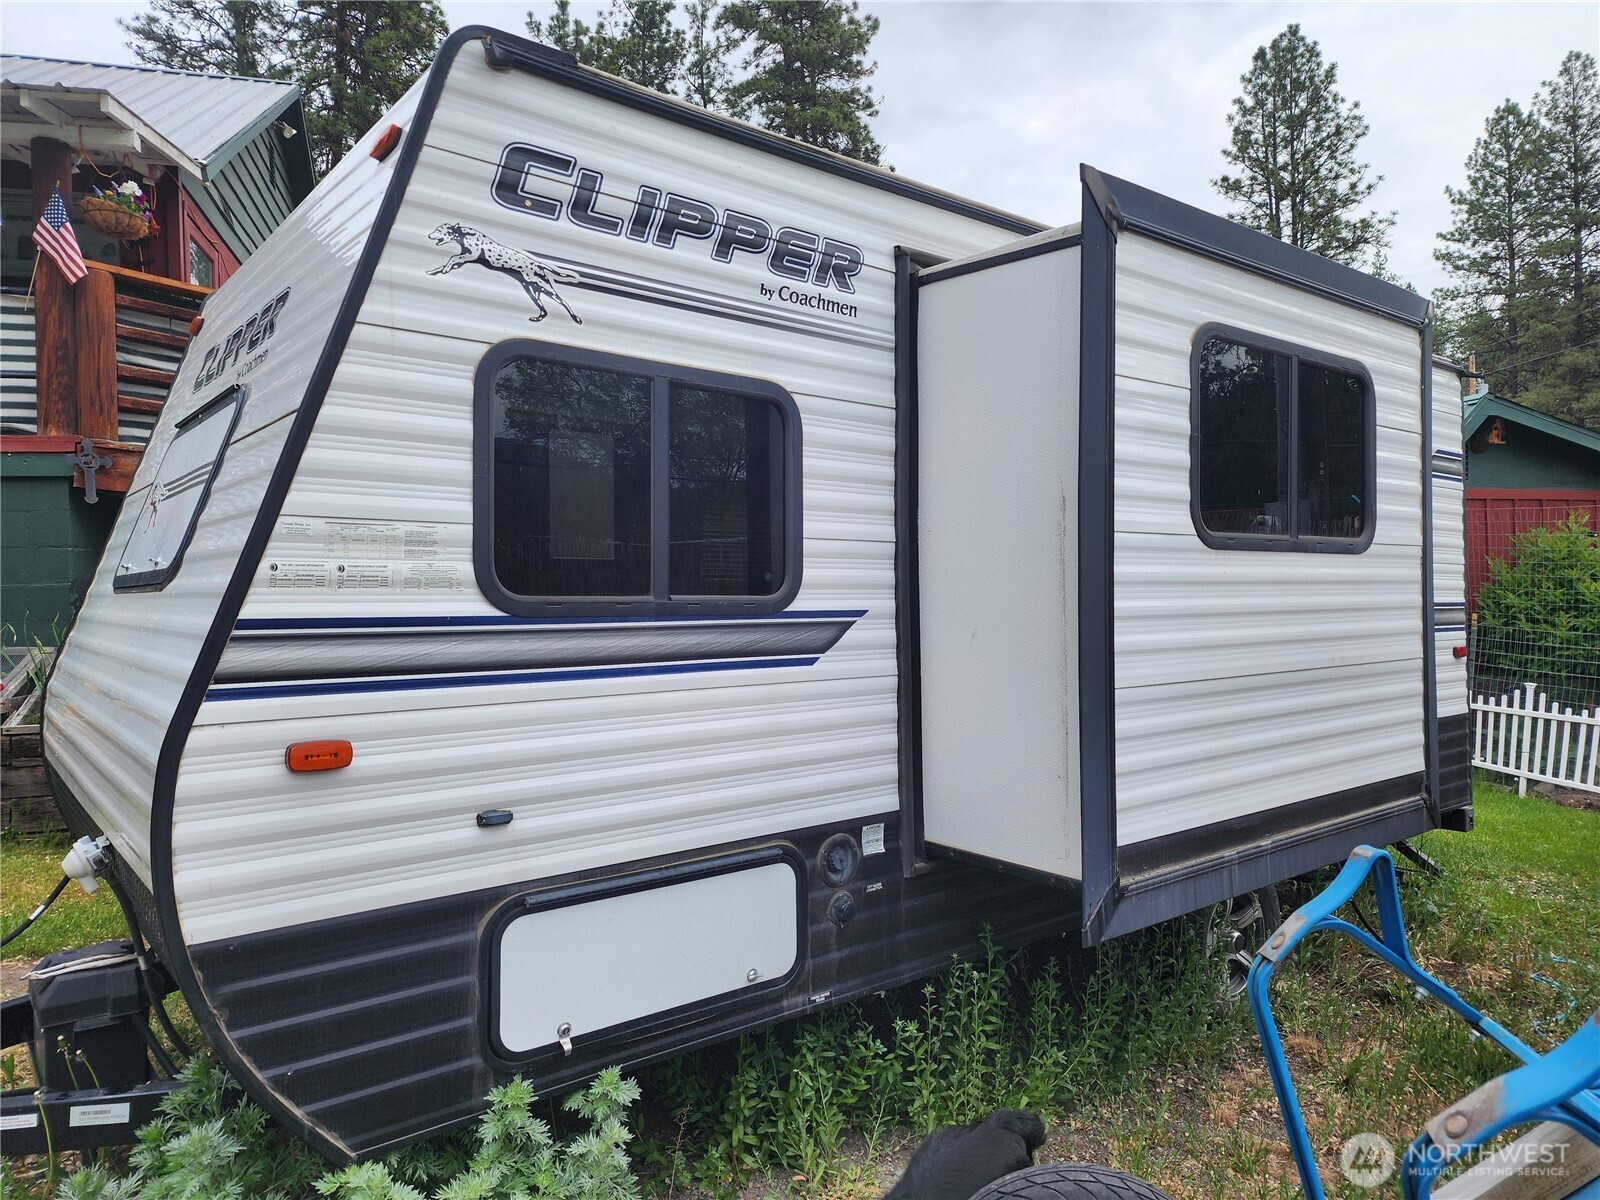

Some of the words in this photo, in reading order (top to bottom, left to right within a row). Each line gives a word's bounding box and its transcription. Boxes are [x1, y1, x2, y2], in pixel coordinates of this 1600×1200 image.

[490, 141, 865, 295] CLIPPER
[193, 286, 291, 394] CLIPPER
[760, 283, 775, 301] by
[778, 285, 858, 318] Coachmen
